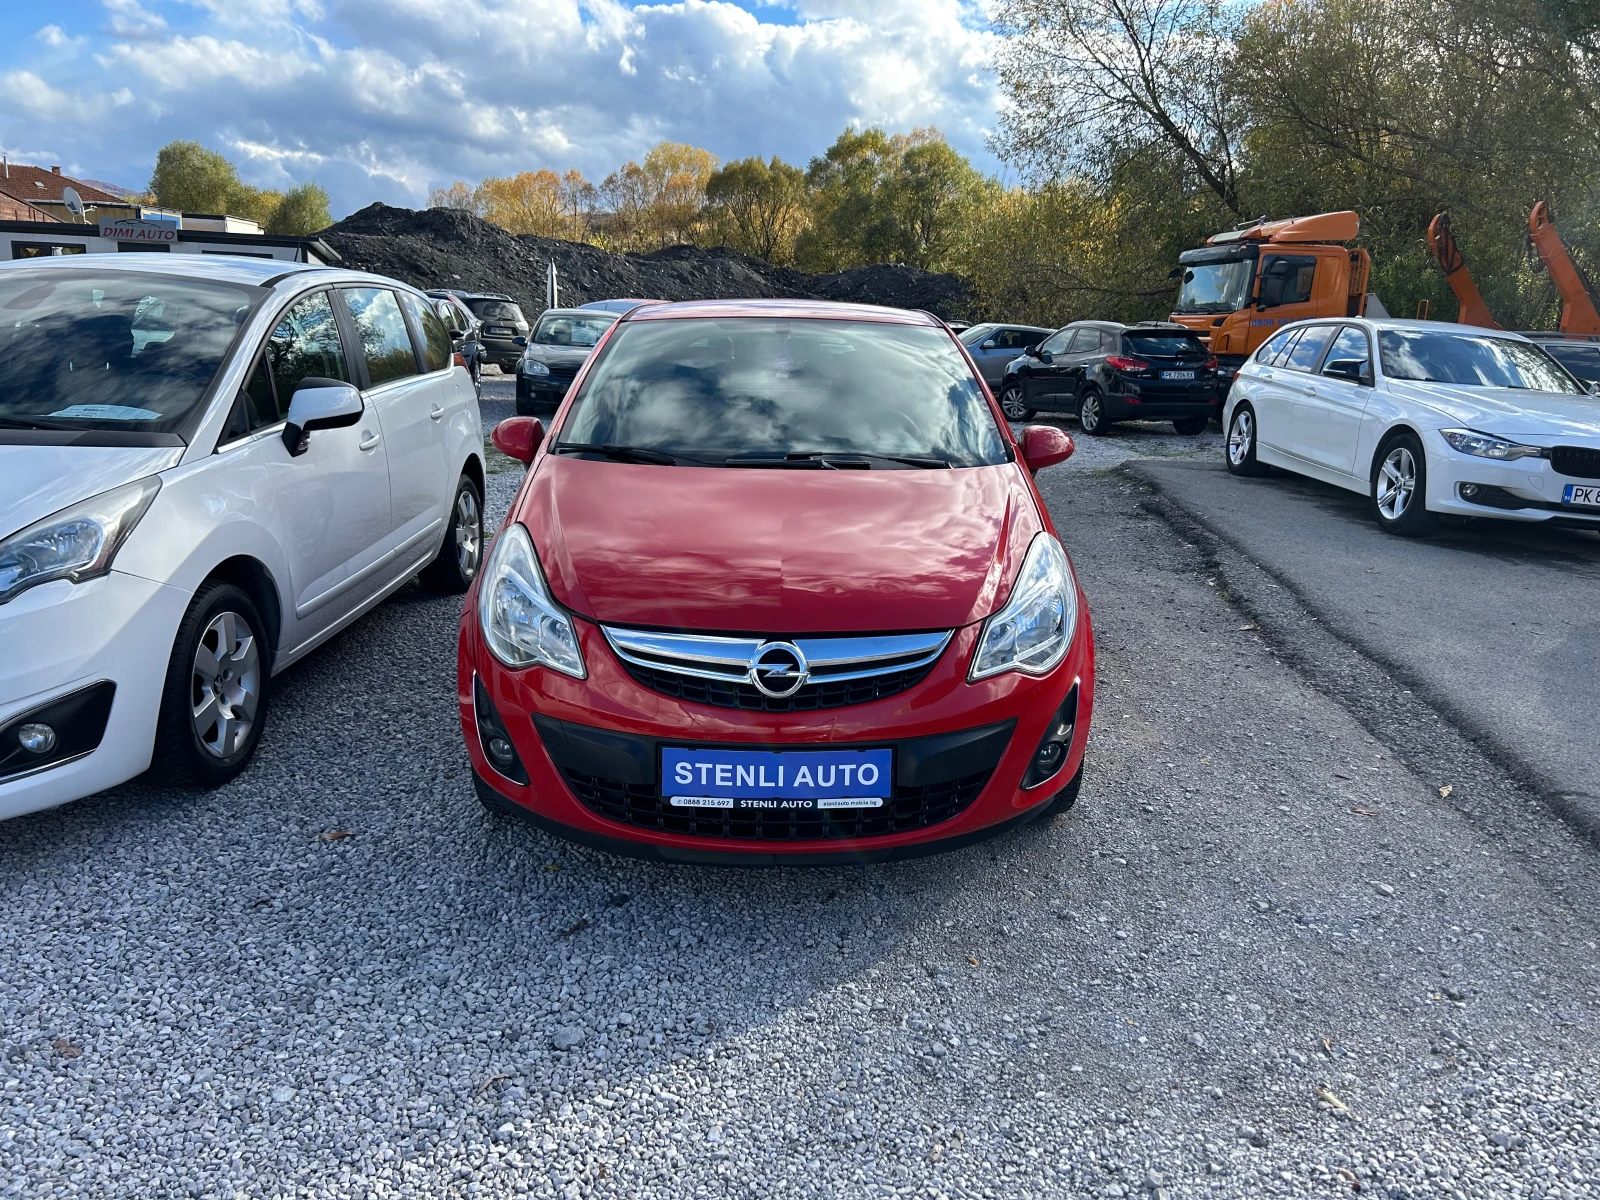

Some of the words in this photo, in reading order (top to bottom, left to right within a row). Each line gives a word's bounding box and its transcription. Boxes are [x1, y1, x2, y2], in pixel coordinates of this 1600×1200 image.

[103, 227, 134, 238] DIMI
[136, 229, 175, 240] AUTO
[1251, 318, 1274, 327] 0898
[1573, 488, 1593, 503] PK
[674, 761, 784, 787] STENLI
[792, 763, 879, 787] AUTO
[740, 800, 778, 808] STENLI
[781, 800, 812, 808] AUTO
